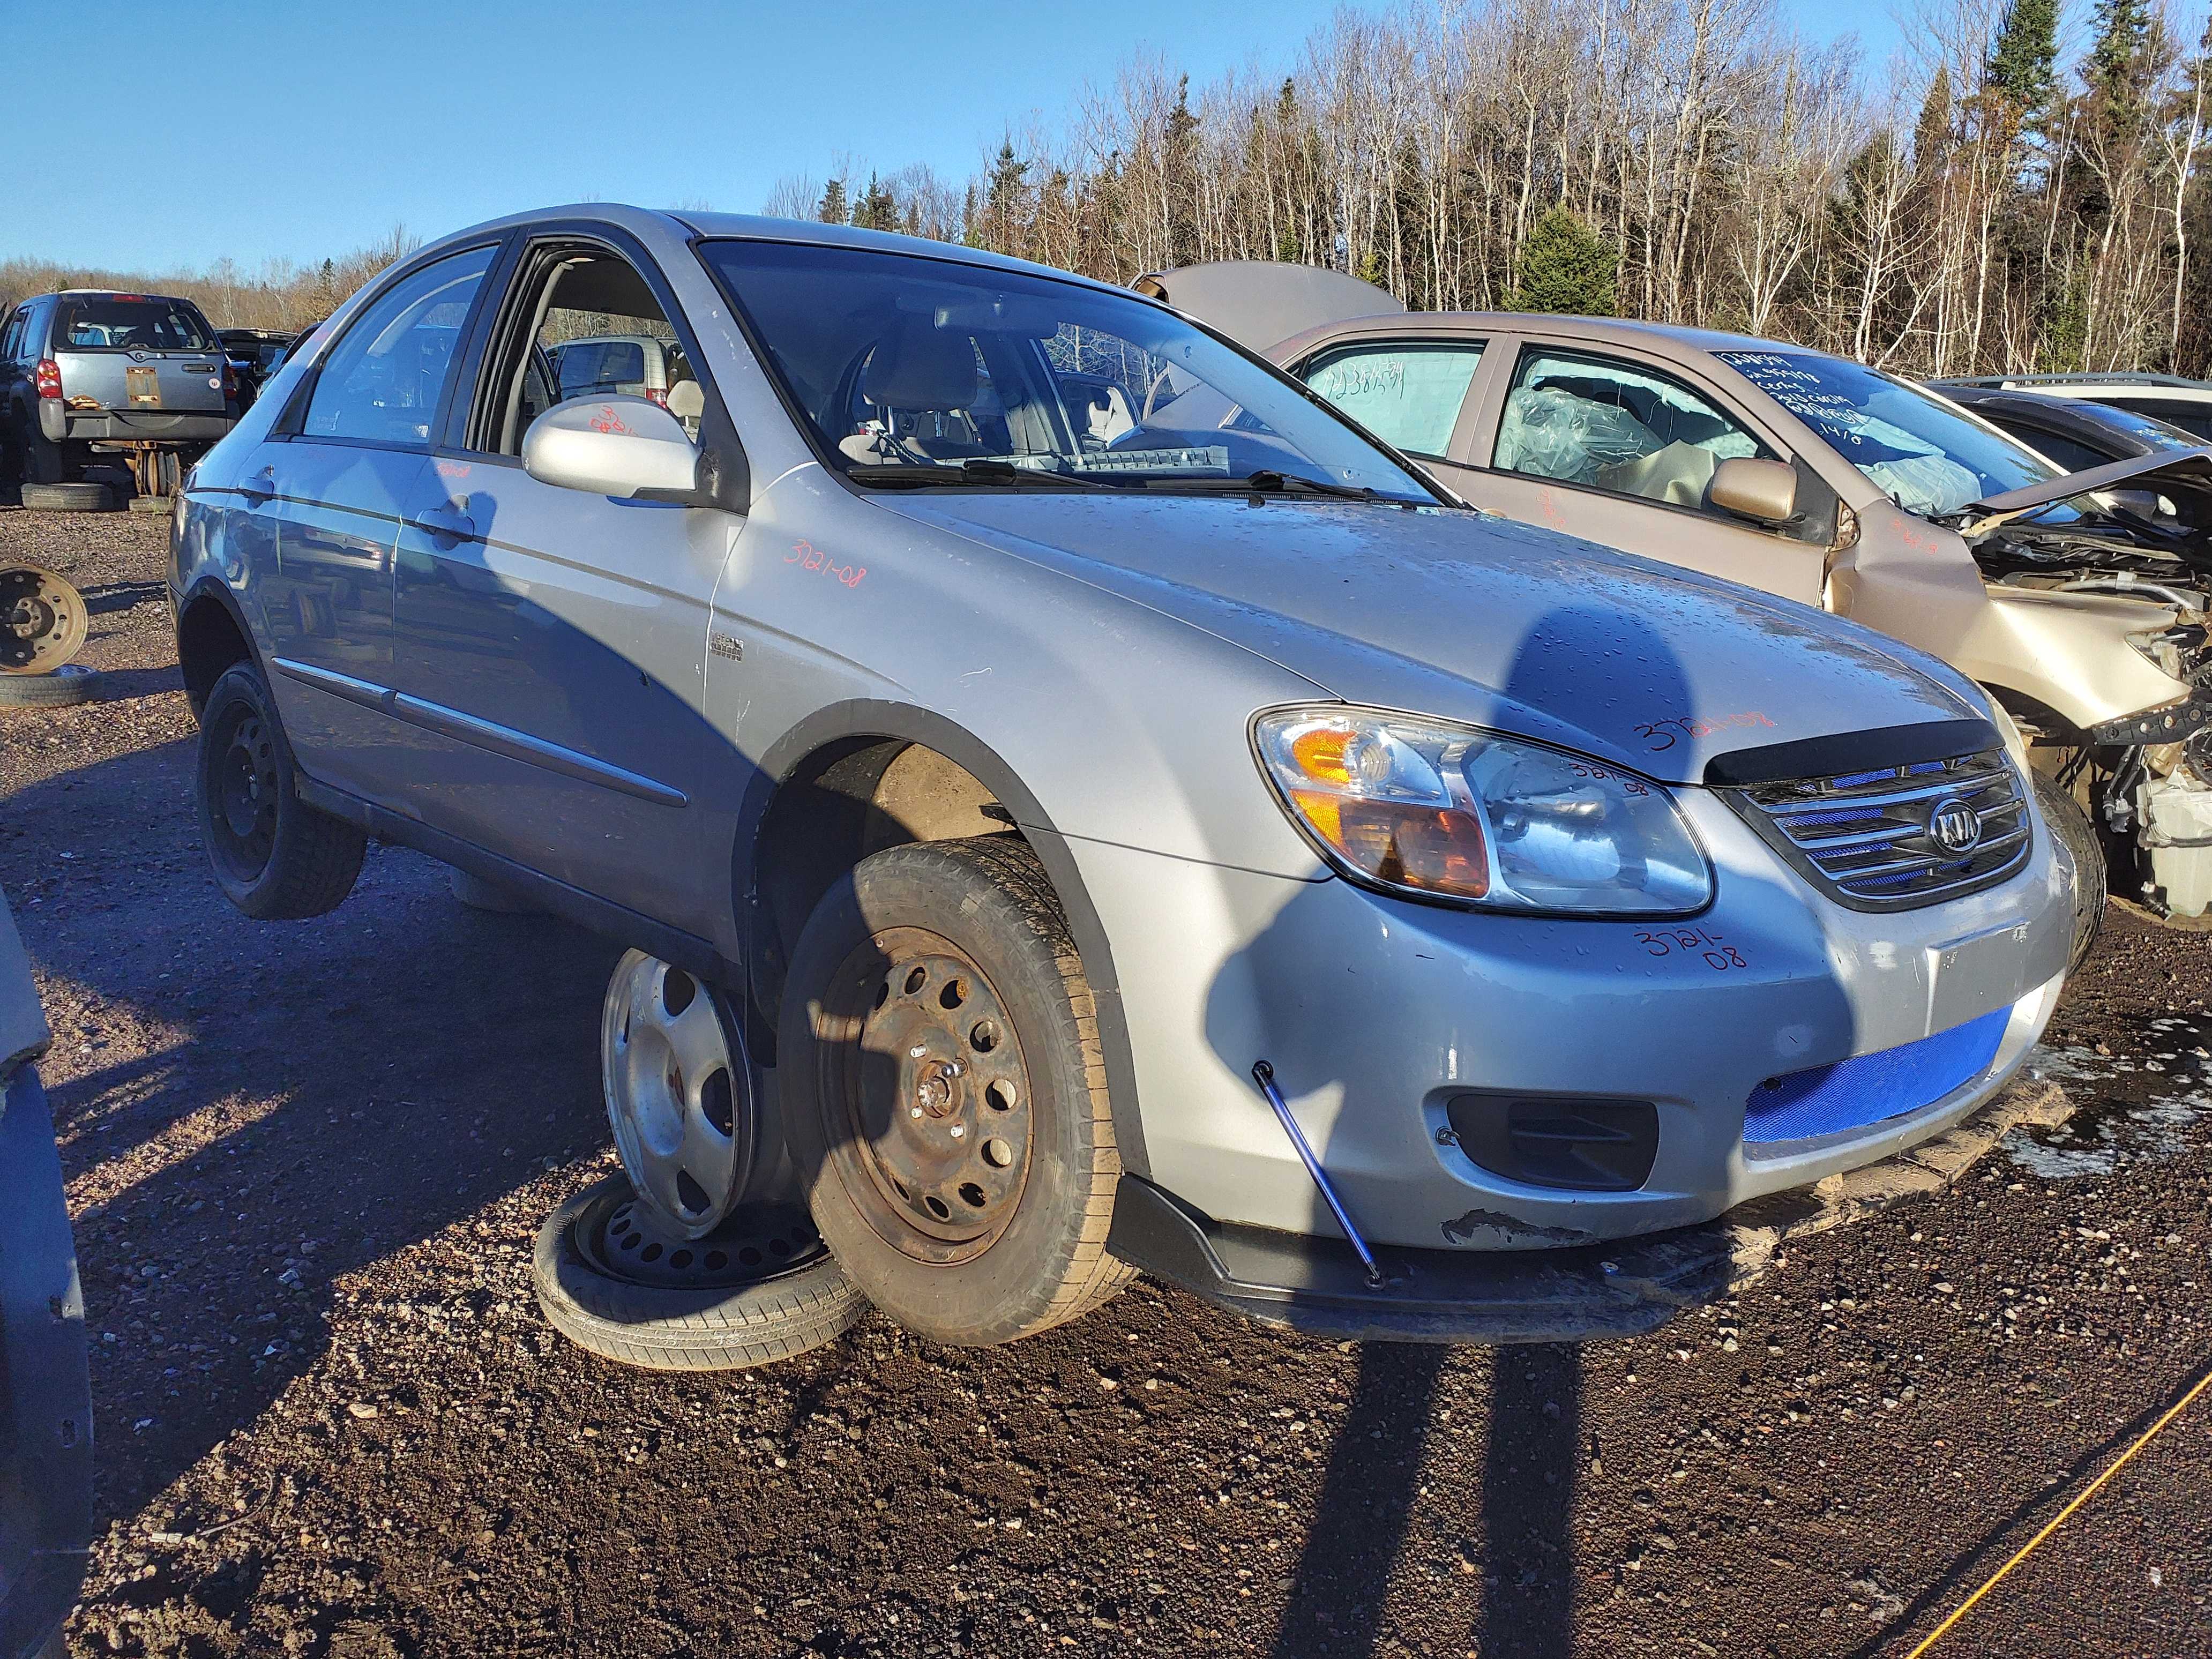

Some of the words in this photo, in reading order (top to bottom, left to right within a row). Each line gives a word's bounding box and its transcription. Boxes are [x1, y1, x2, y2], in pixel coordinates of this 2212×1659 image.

[1624, 782, 1649, 796] 08
[1937, 810, 1977, 844] KIA
[1702, 946, 1747, 970] 08
